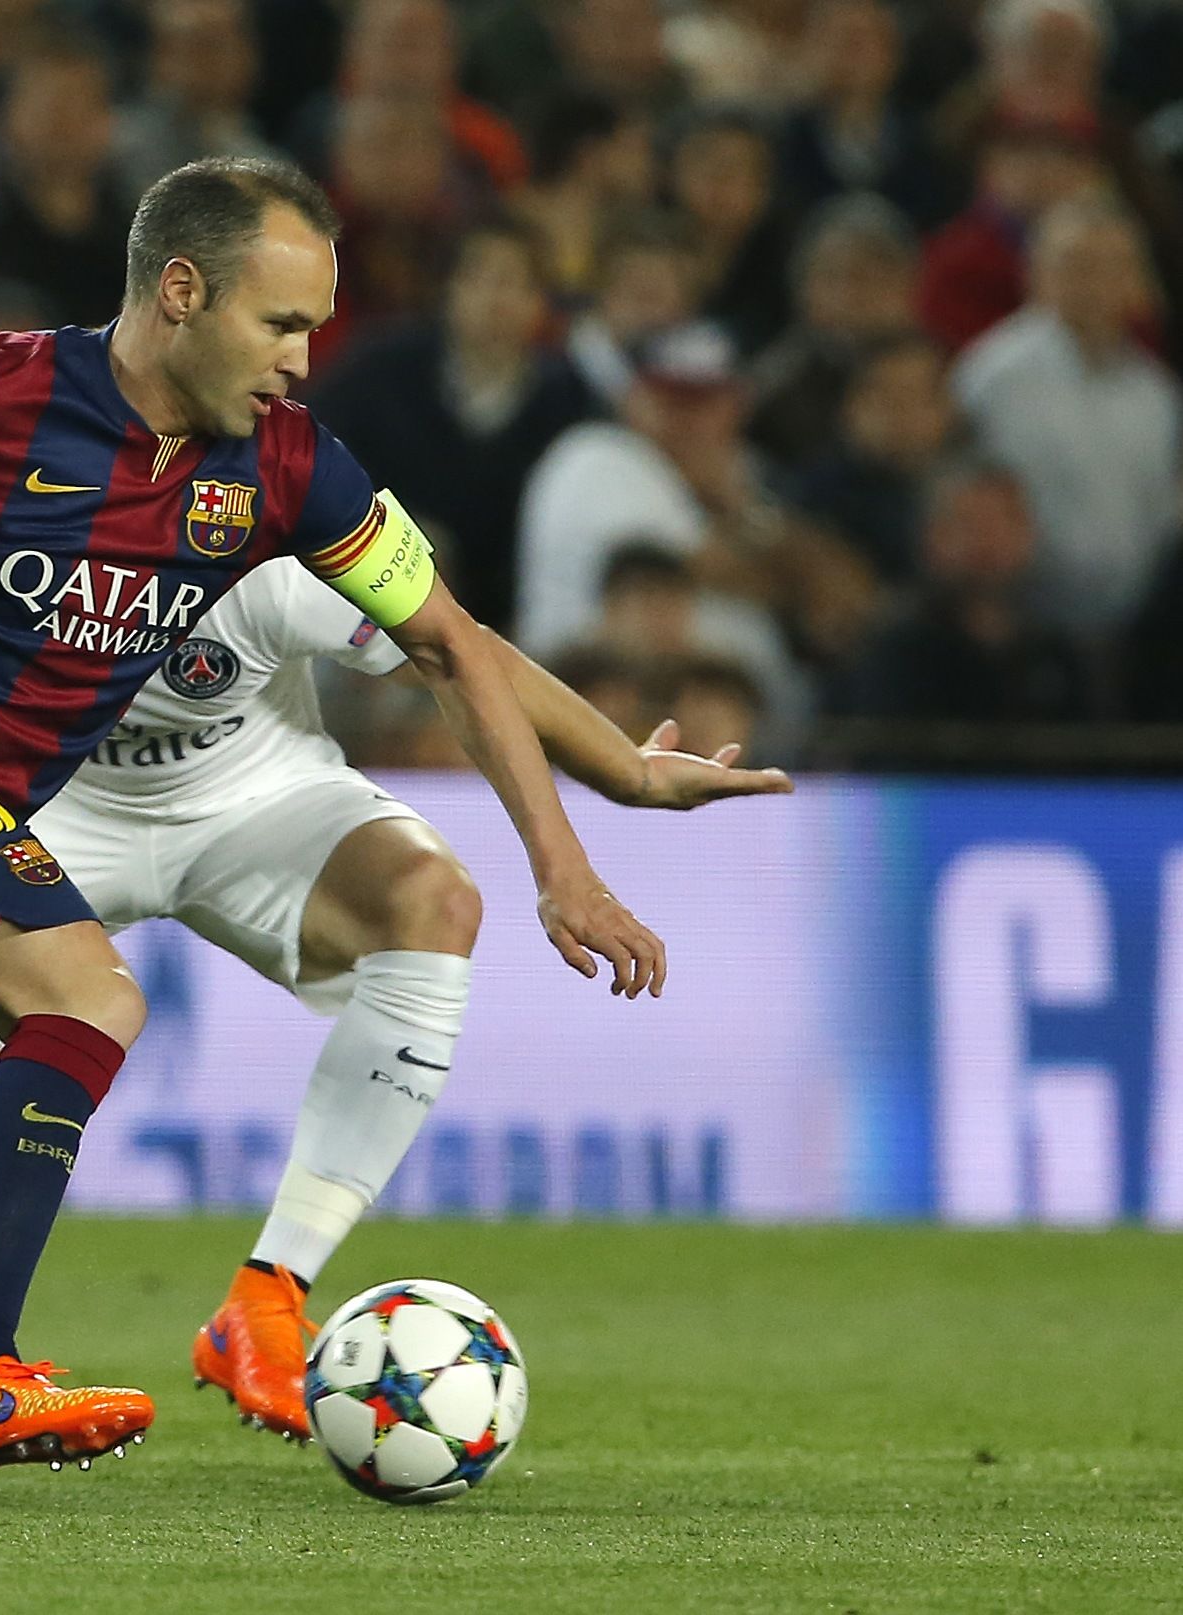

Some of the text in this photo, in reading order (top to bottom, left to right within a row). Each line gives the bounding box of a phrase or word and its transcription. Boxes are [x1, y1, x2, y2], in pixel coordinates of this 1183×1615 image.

[207, 513, 234, 526] FCB
[0, 549, 205, 629] QATAR
[368, 568, 394, 593] NO
[389, 547, 407, 568] TO
[33, 609, 170, 655] AIRWAYS
